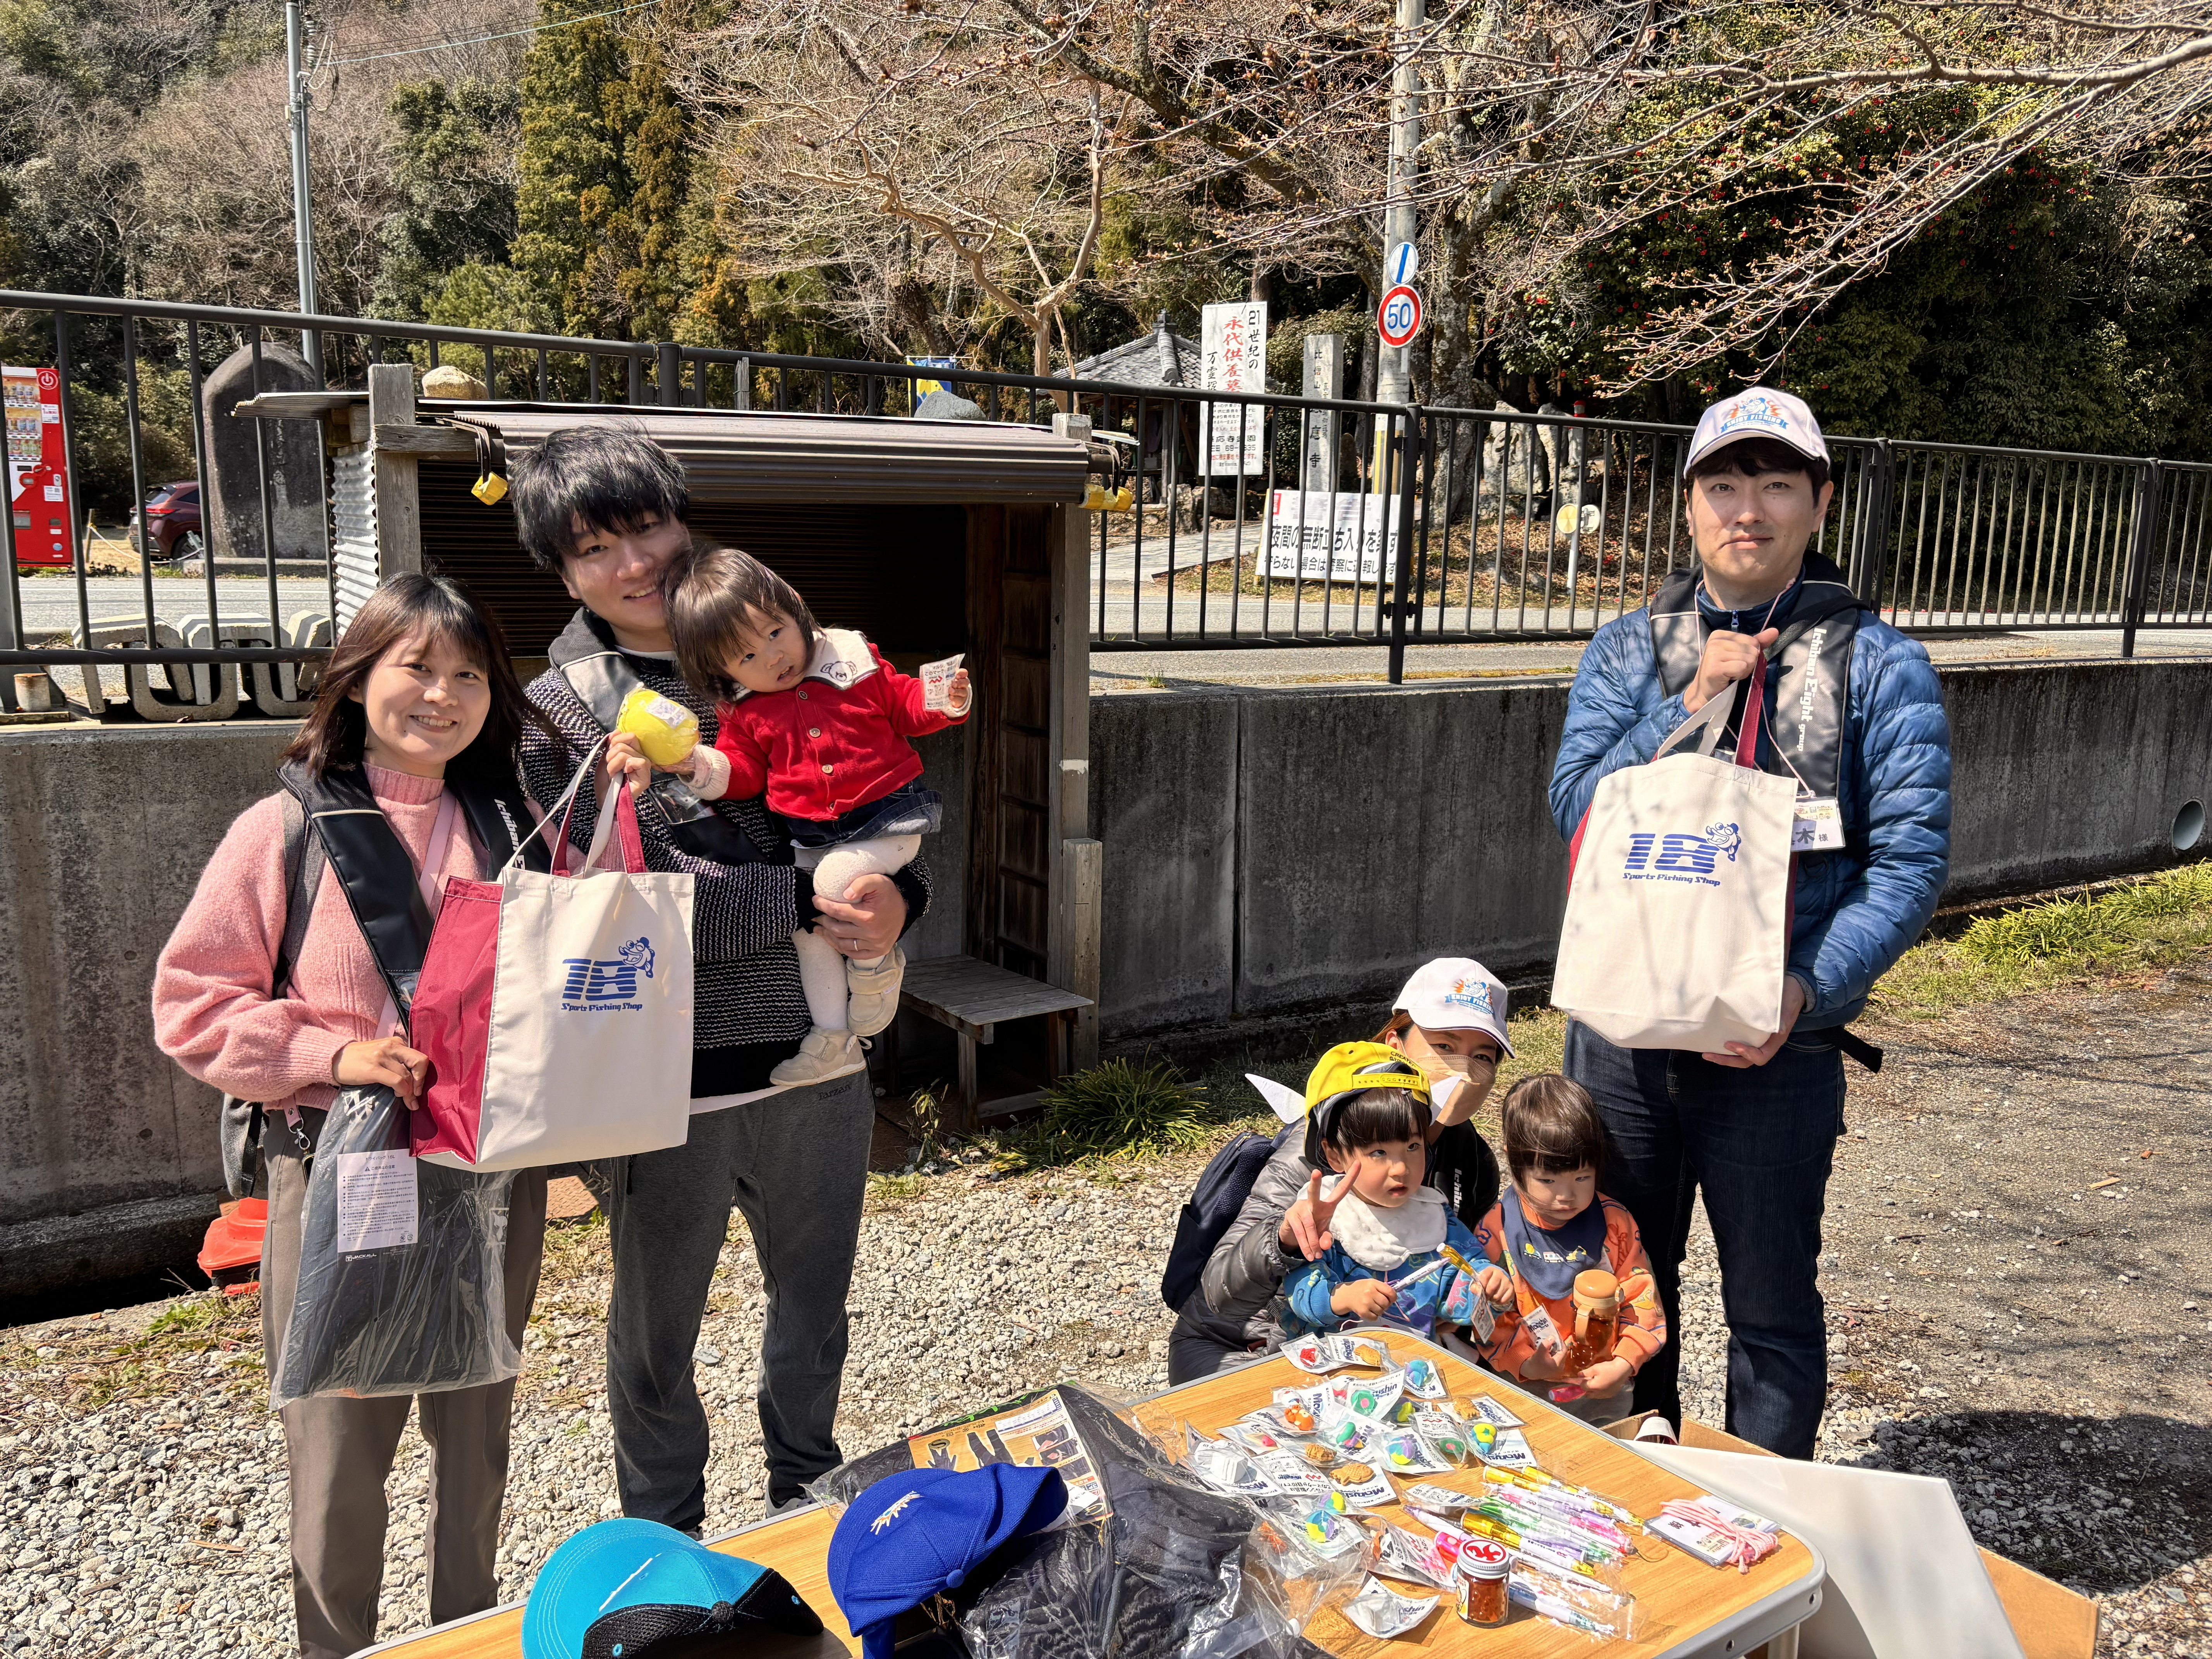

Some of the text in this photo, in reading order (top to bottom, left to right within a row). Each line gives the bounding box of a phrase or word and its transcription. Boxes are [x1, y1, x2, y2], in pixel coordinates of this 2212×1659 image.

[1388, 303, 1410, 329] 50
[1248, 310, 1260, 369] 21世紀の
[1223, 316, 1244, 393] 永代供養墓
[1726, 415, 1748, 427] ENJOY
[1750, 414, 1781, 424] FISHING
[1796, 628, 1827, 752] Ichiban Eight group
[494, 799, 519, 852] Ichiban
[1657, 874, 1693, 883] Fishing
[1694, 876, 1721, 887] Shop
[561, 1002, 643, 1012] Sports Fishing Shop
[1451, 994, 1472, 1002] ENJOY
[1472, 998, 1494, 1014] FISHING
[817, 1084, 851, 1100] Tarzan
